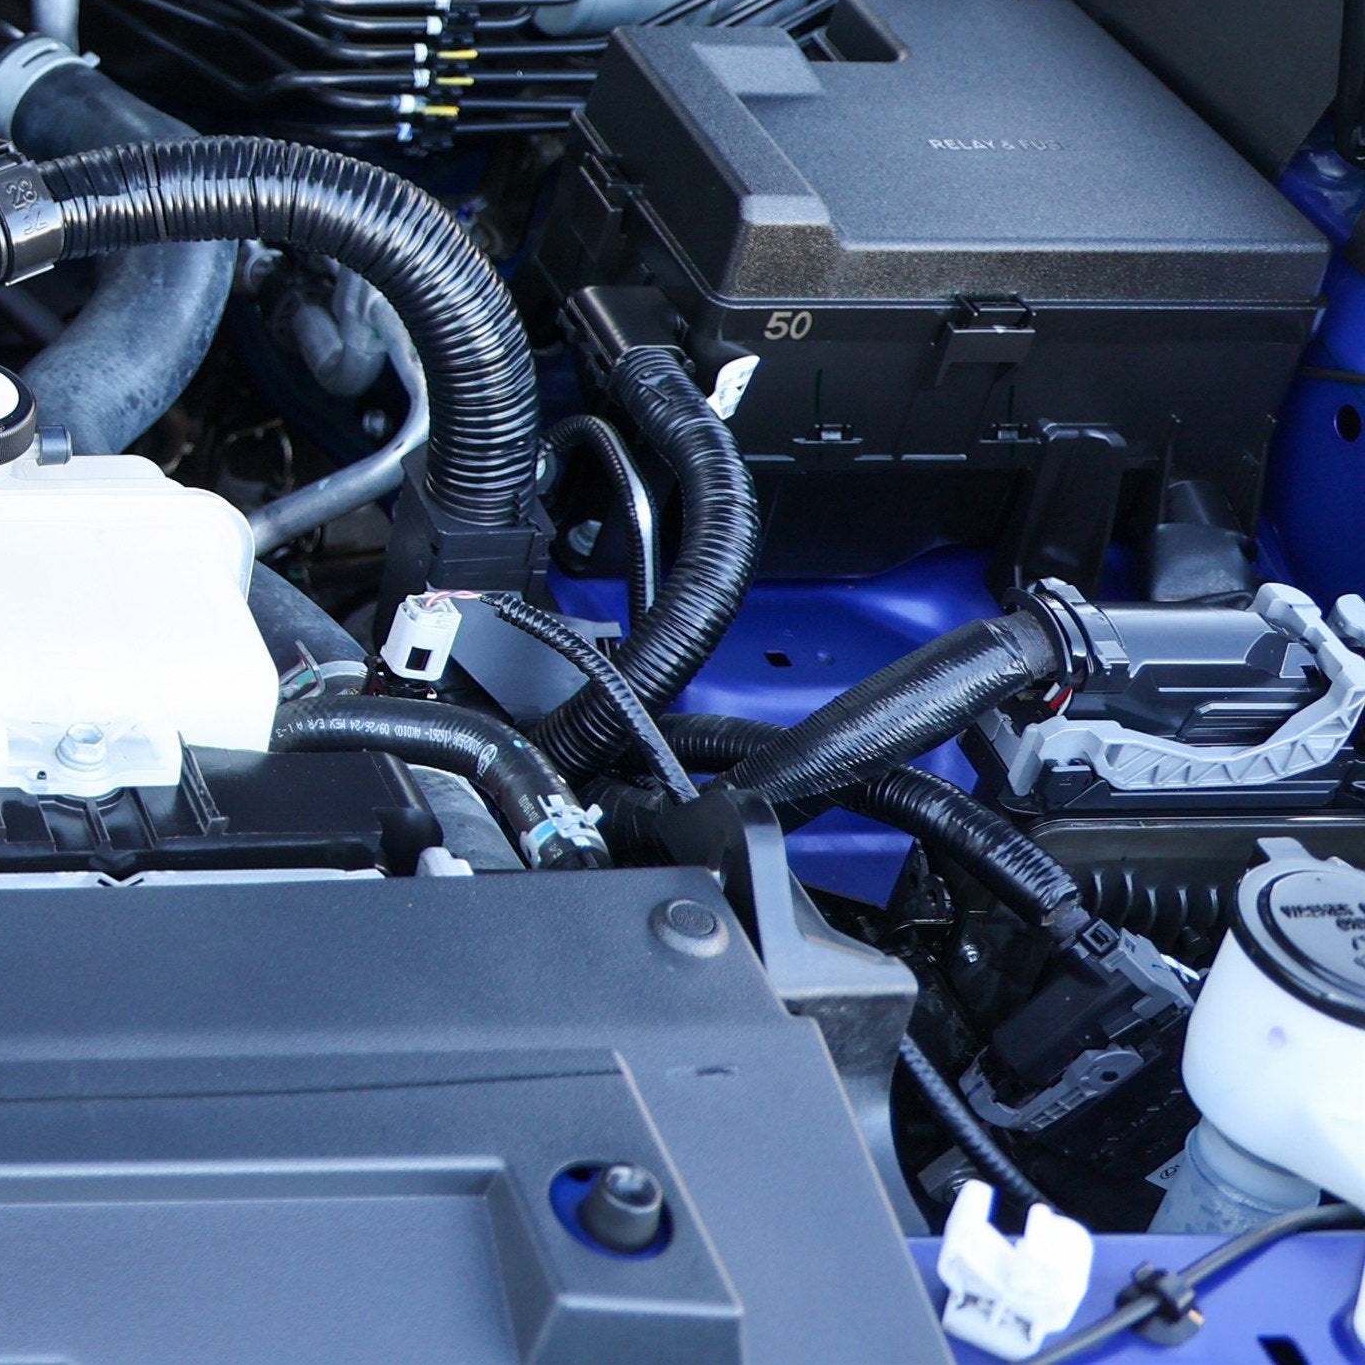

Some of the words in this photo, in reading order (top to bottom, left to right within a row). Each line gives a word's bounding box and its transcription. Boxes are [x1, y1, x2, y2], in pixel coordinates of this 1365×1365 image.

[928, 138, 996, 151] RELAY
[1001, 139, 1015, 150] &
[764, 311, 814, 340] 50
